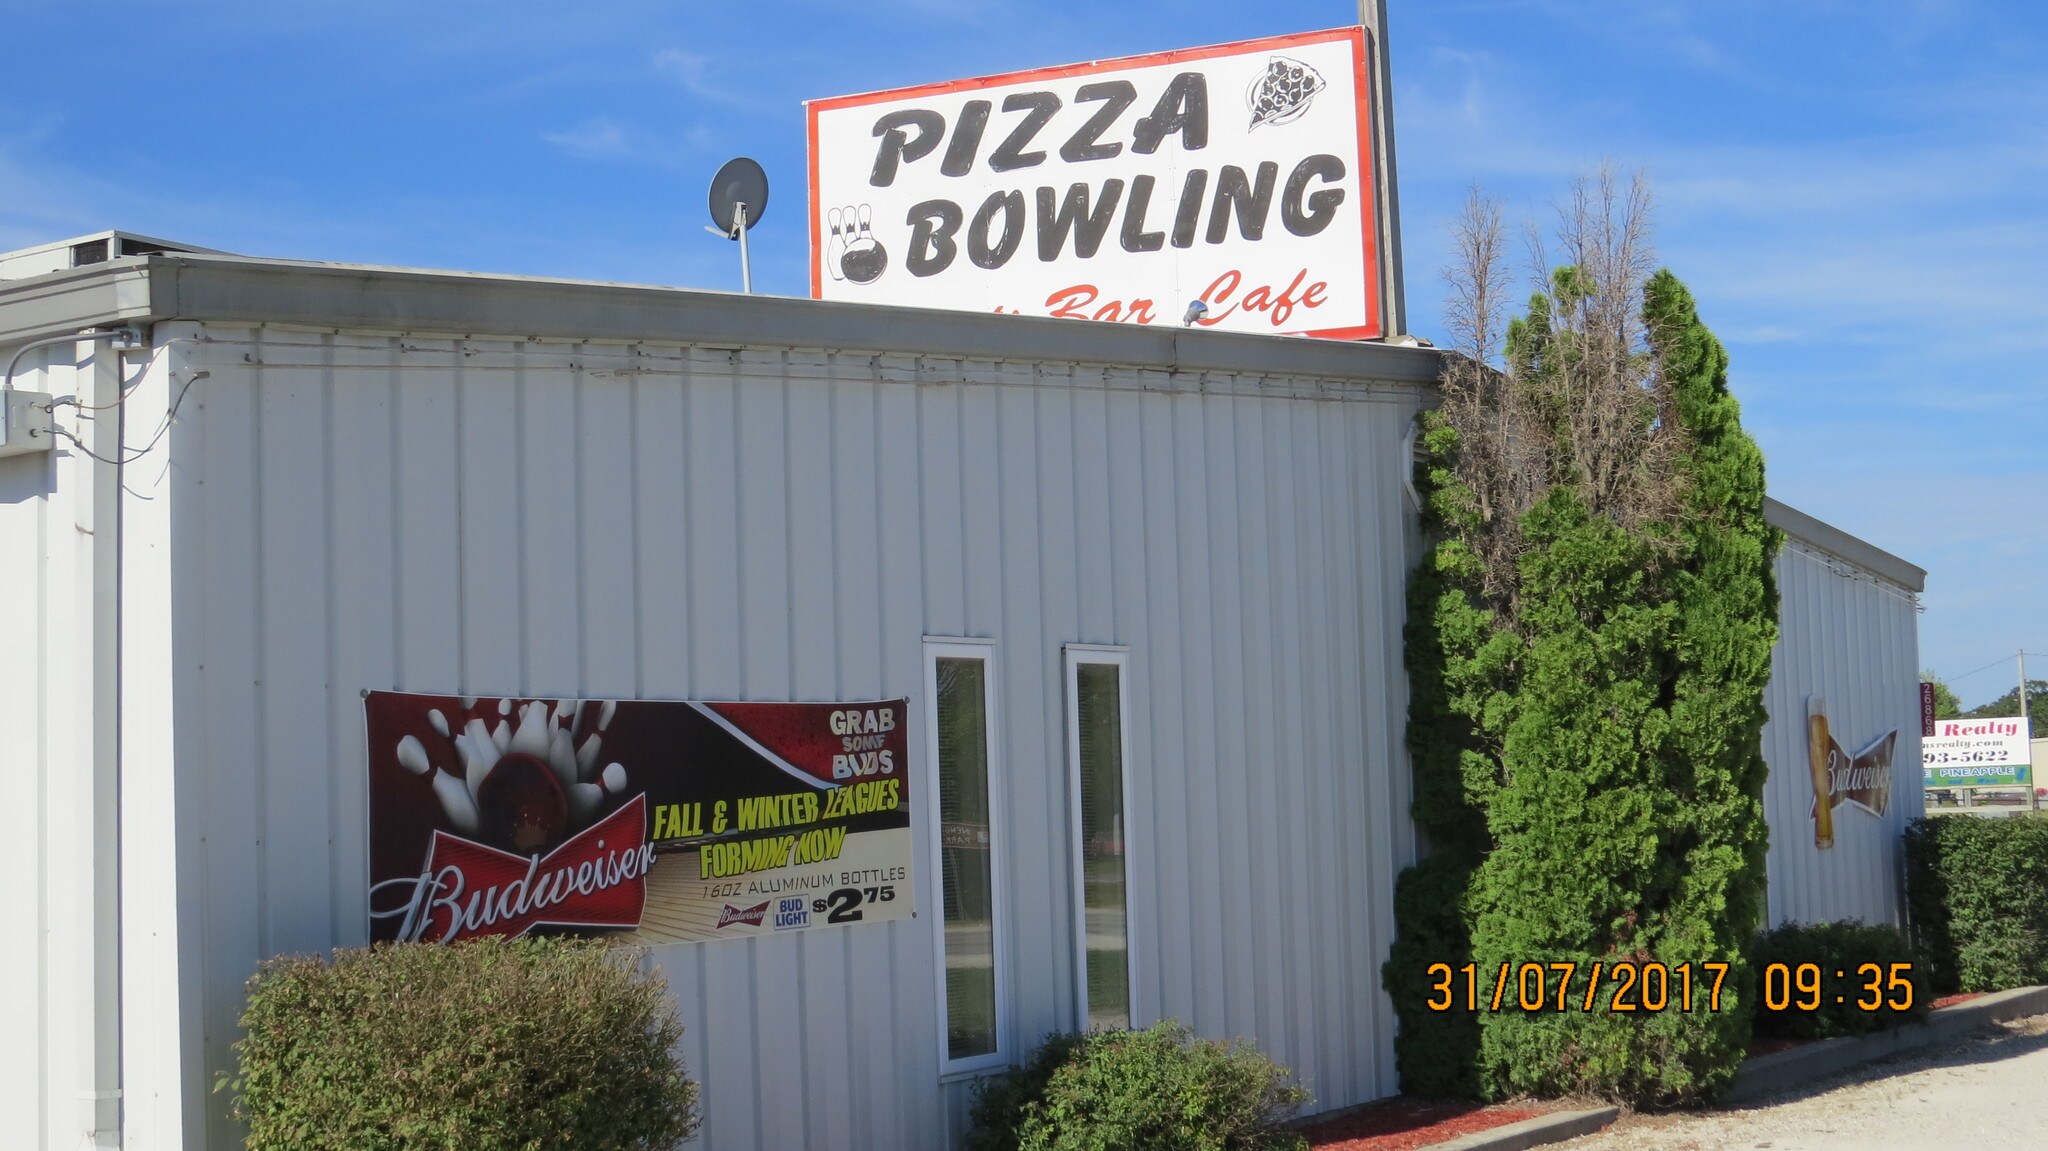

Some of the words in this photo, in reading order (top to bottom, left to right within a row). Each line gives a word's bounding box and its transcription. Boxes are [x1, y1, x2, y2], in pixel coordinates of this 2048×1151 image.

[869, 72, 1208, 187] PIZZA
[905, 154, 1346, 277] BOWLING
[1045, 284, 1156, 324] Bar
[1196, 268, 1328, 326] Cafe
[830, 708, 895, 735] GRAB
[1944, 721, 2018, 736] Realty
[832, 749, 894, 779] BUDS
[1940, 766, 2015, 777] PINEAPPLE
[653, 802, 703, 839] FALL
[712, 800, 728, 834] &
[737, 791, 819, 831] WINTER
[822, 778, 900, 819] LEAGUES
[700, 834, 795, 879] FORMING
[794, 826, 847, 865] NOW
[369, 840, 657, 944] Budweiser
[748, 874, 833, 895] ALUMINUM
[841, 867, 906, 885] BOTTLES
[720, 908, 765, 923] Budweiser
[776, 912, 808, 927] LIGHT
[780, 899, 803, 913] BUD
